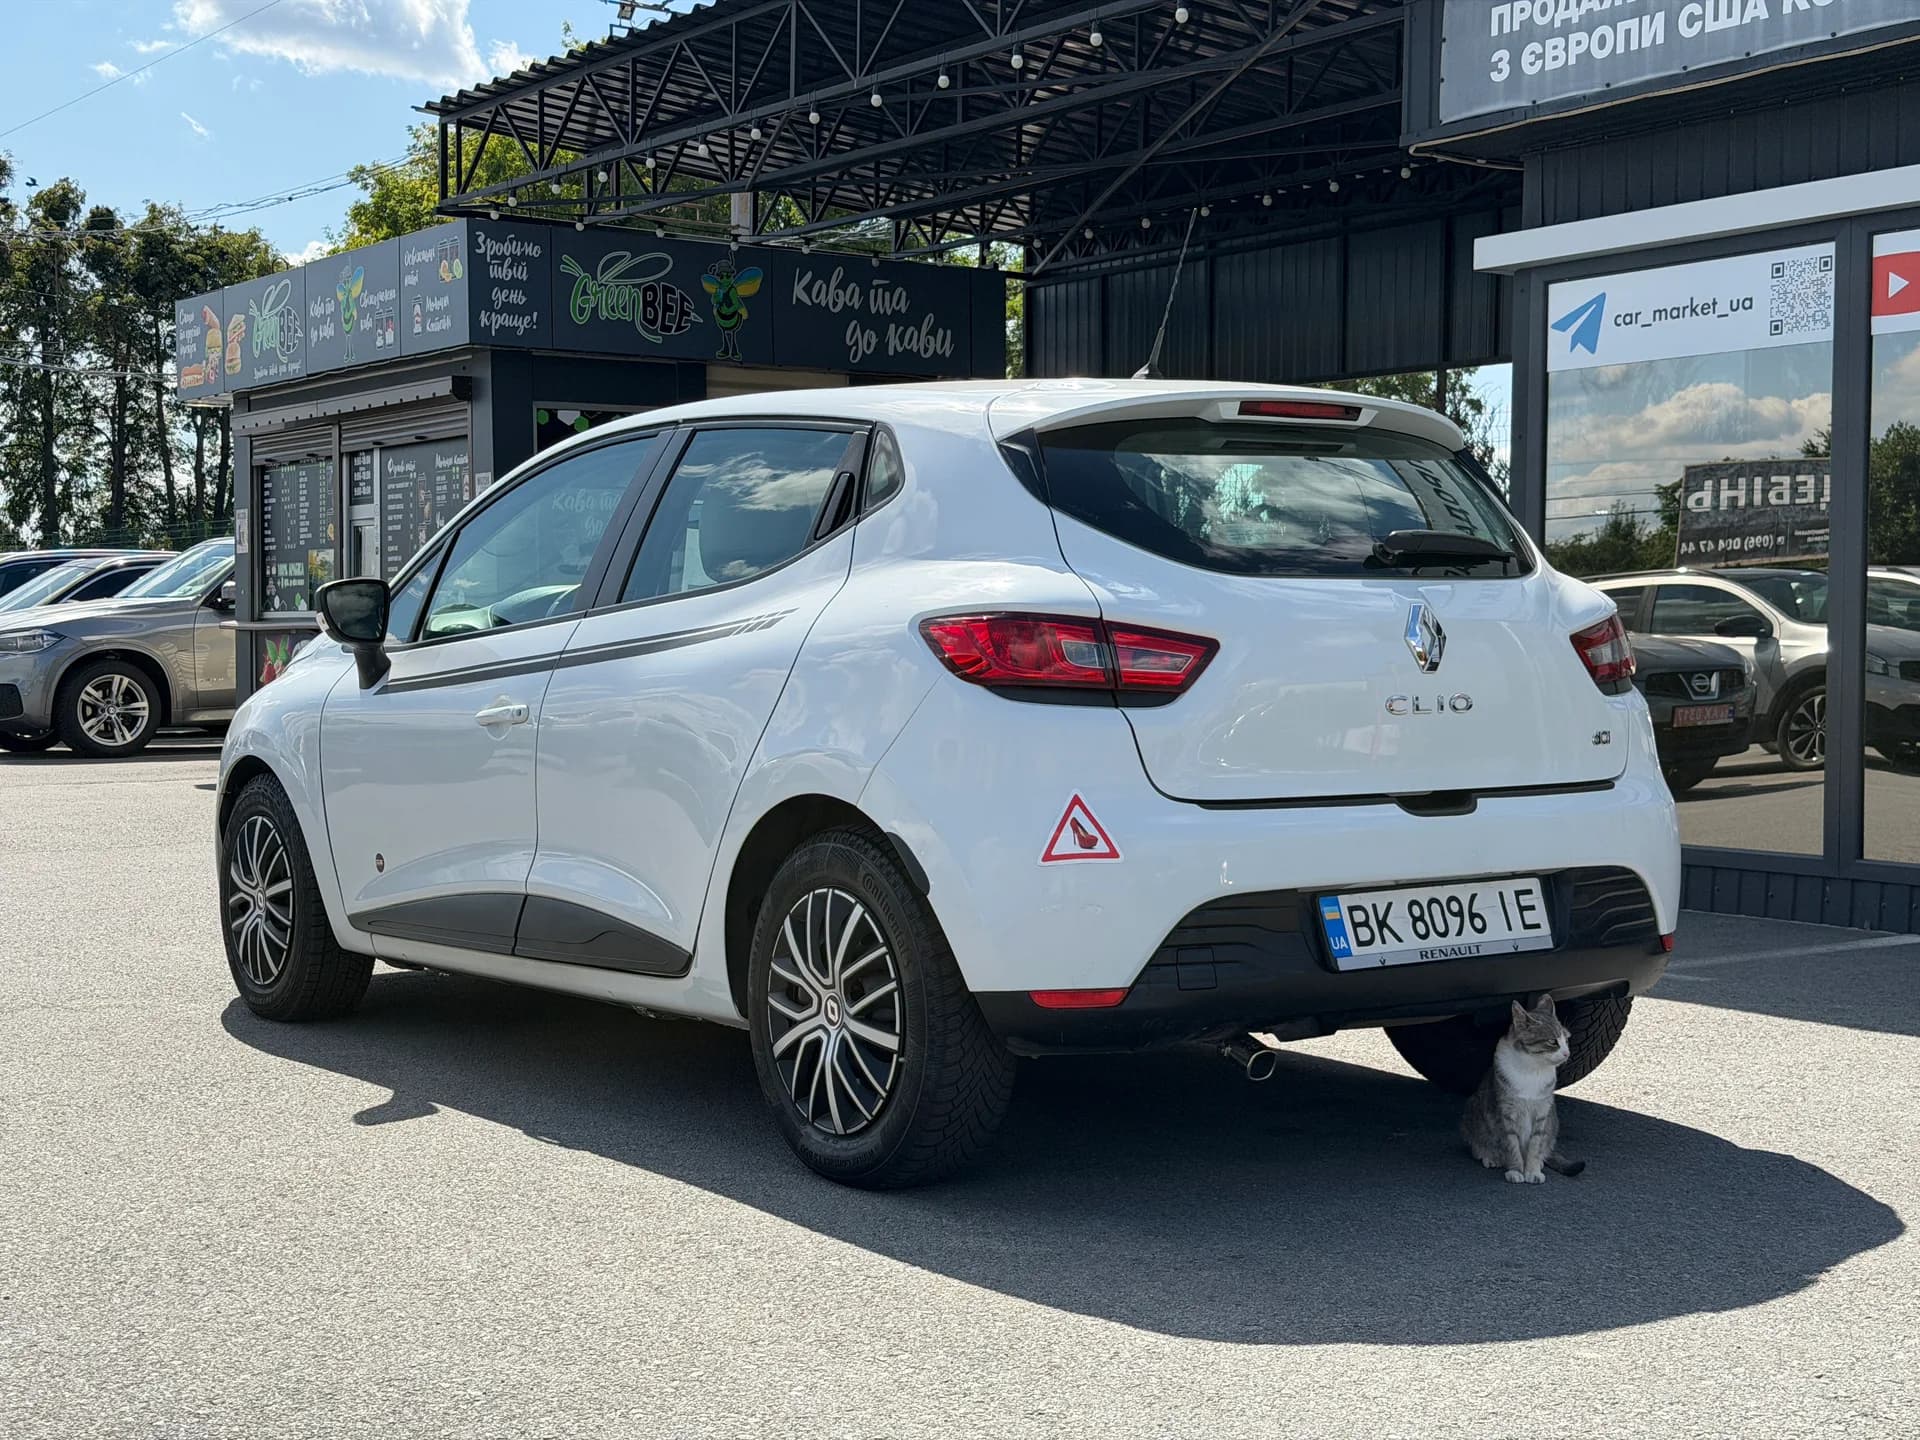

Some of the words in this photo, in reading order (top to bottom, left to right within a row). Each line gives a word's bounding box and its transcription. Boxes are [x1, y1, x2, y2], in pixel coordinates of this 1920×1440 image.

[1491, 0, 1637, 37] ПРОД
[1490, 49, 1510, 82] З
[1521, 10, 1665, 75] ЄВРОПИ
[1678, 0, 1769, 38] США
[475, 231, 542, 262] Зробимо
[489, 257, 529, 281] твій
[491, 287, 527, 310] день
[792, 266, 864, 313] Кава
[869, 279, 911, 316] та
[479, 309, 538, 336] краще!
[1613, 294, 1754, 329] car_market_ua
[845, 320, 878, 363] до
[885, 313, 954, 358] кави
[1385, 692, 1473, 715] CLIO
[1347, 901, 1404, 948] BK
[1407, 892, 1488, 941] 8096
[1498, 888, 1542, 932] IE
[1331, 935, 1348, 951] UA
[1419, 944, 1483, 961] RENAULT
